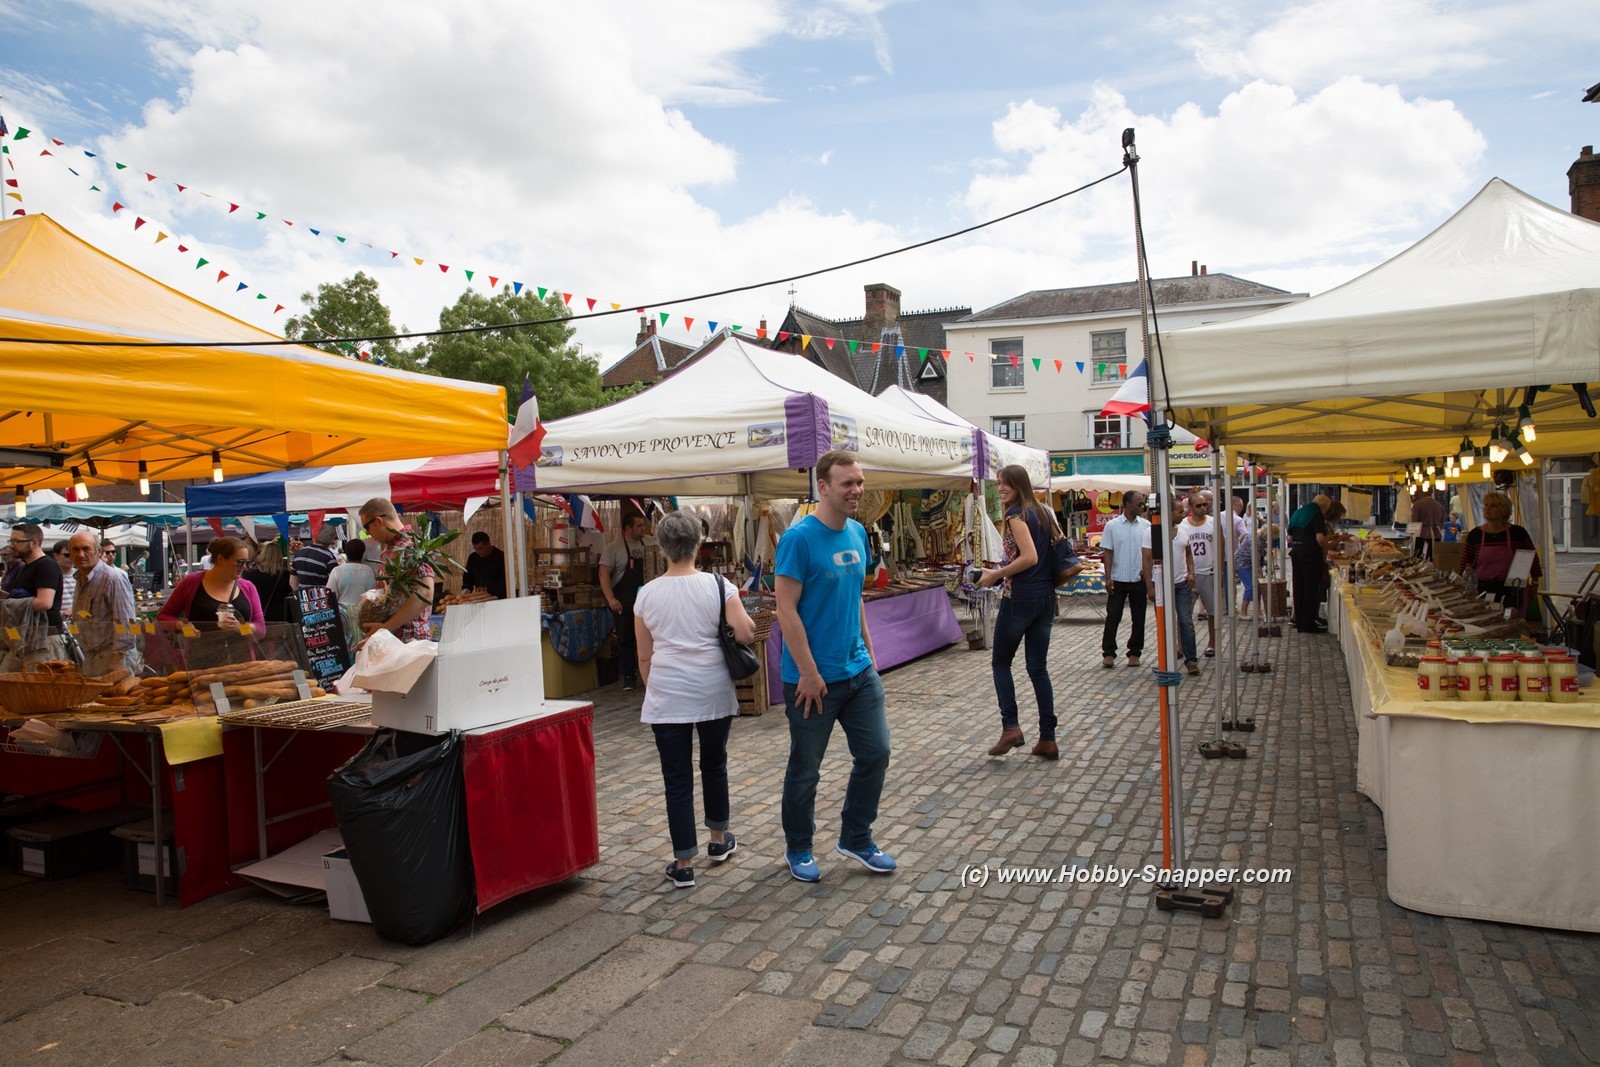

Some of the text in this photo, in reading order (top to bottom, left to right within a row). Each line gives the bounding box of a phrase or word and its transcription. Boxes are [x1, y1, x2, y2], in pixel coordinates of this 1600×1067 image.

[571, 431, 736, 462] SAVON DE PROVENCE
[865, 426, 904, 453] SAVON
[903, 433, 917, 452] DE
[1193, 541, 1206, 556] 23
